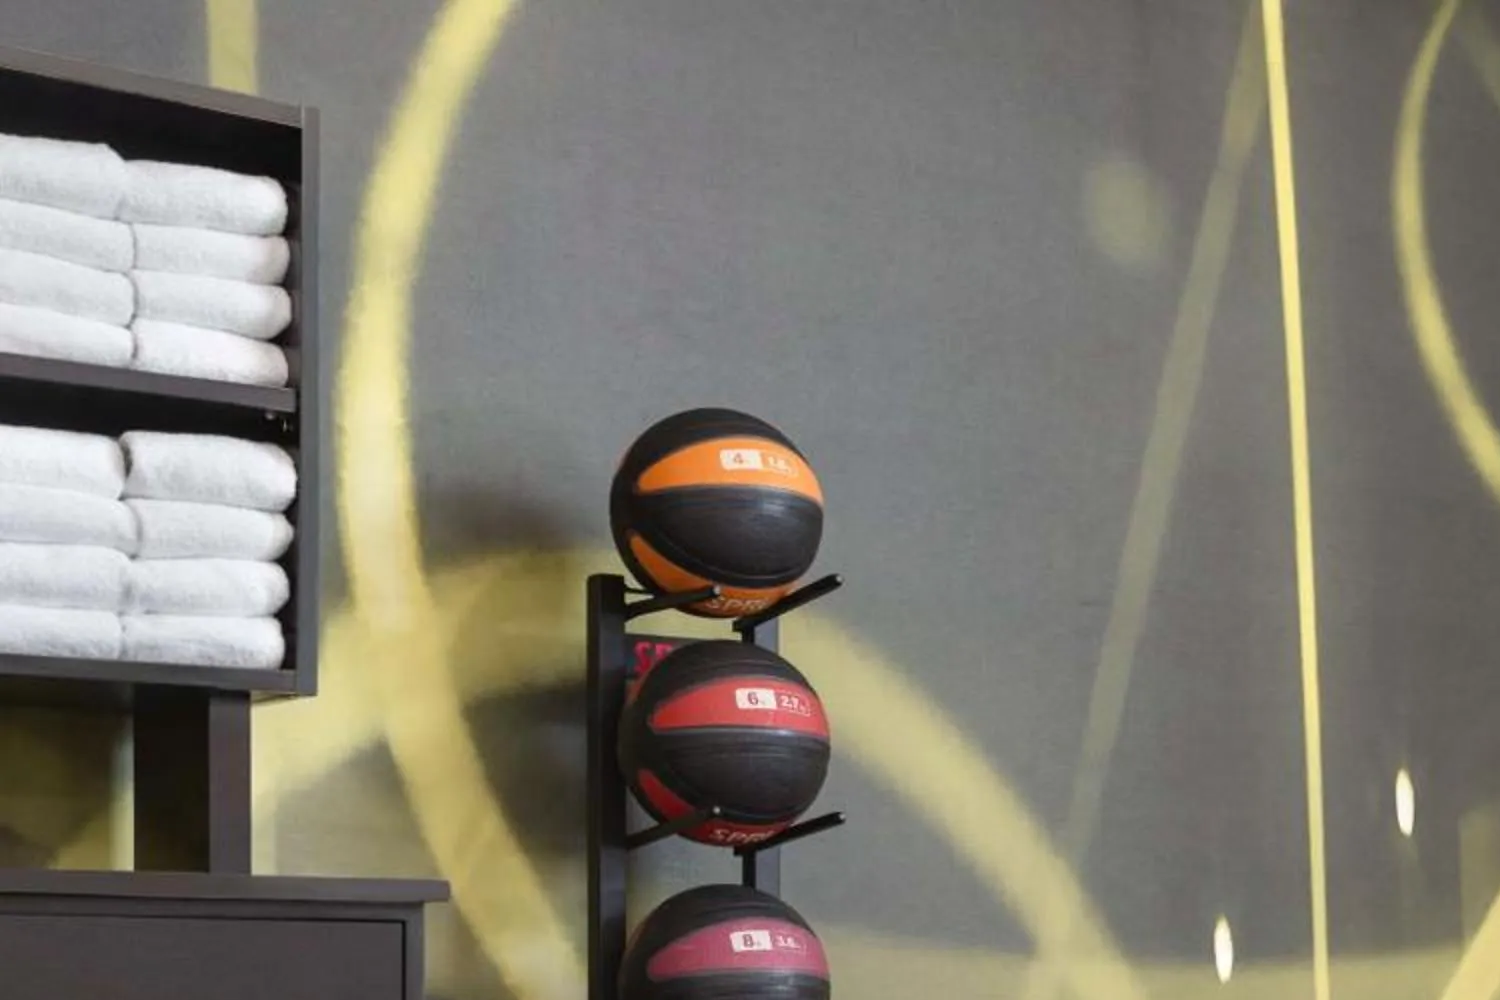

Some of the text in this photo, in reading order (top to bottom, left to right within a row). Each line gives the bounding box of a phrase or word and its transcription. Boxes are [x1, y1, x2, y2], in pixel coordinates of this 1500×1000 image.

[732, 451, 744, 465] 4
[747, 691, 759, 706] 6
[742, 933, 754, 949] 8
